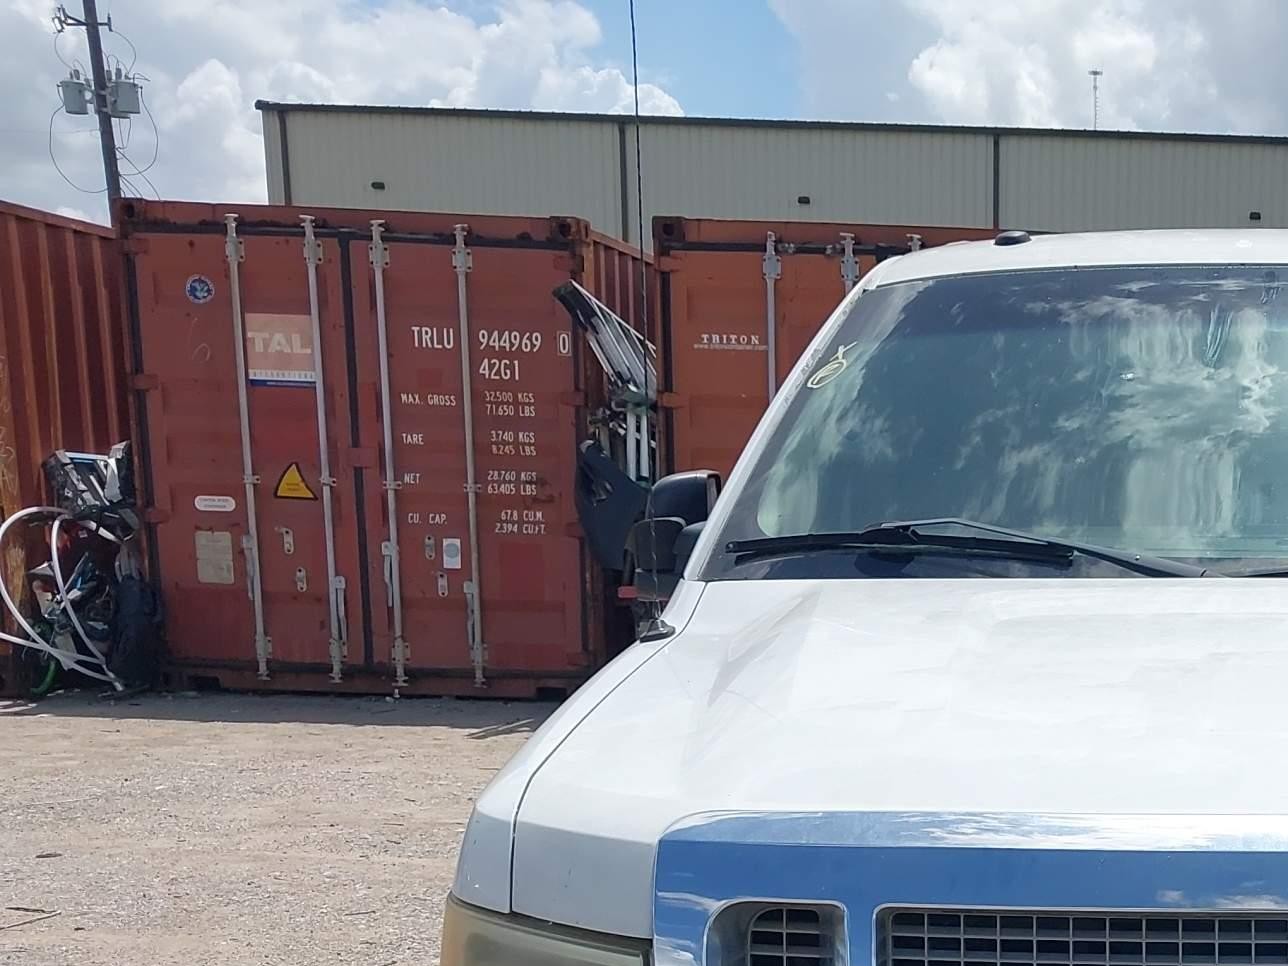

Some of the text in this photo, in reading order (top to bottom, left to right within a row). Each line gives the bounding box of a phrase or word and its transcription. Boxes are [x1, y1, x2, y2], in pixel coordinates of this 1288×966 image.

[247, 331, 312, 354] TAL
[411, 326, 569, 354] TRLU 944969 0
[701, 334, 760, 345] TRITON
[479, 358, 520, 380] 42G1
[428, 394, 456, 406] GROSS
[518, 392, 534, 403] KGS
[519, 405, 536, 417] LBS
[402, 433, 424, 445] TARE
[518, 432, 535, 444] KGS
[520, 446, 537, 456] LBS
[404, 473, 421, 484] NET
[520, 471, 537, 482] KGS
[520, 485, 537, 496] LBS
[408, 513, 448, 525] CU. CAP.
